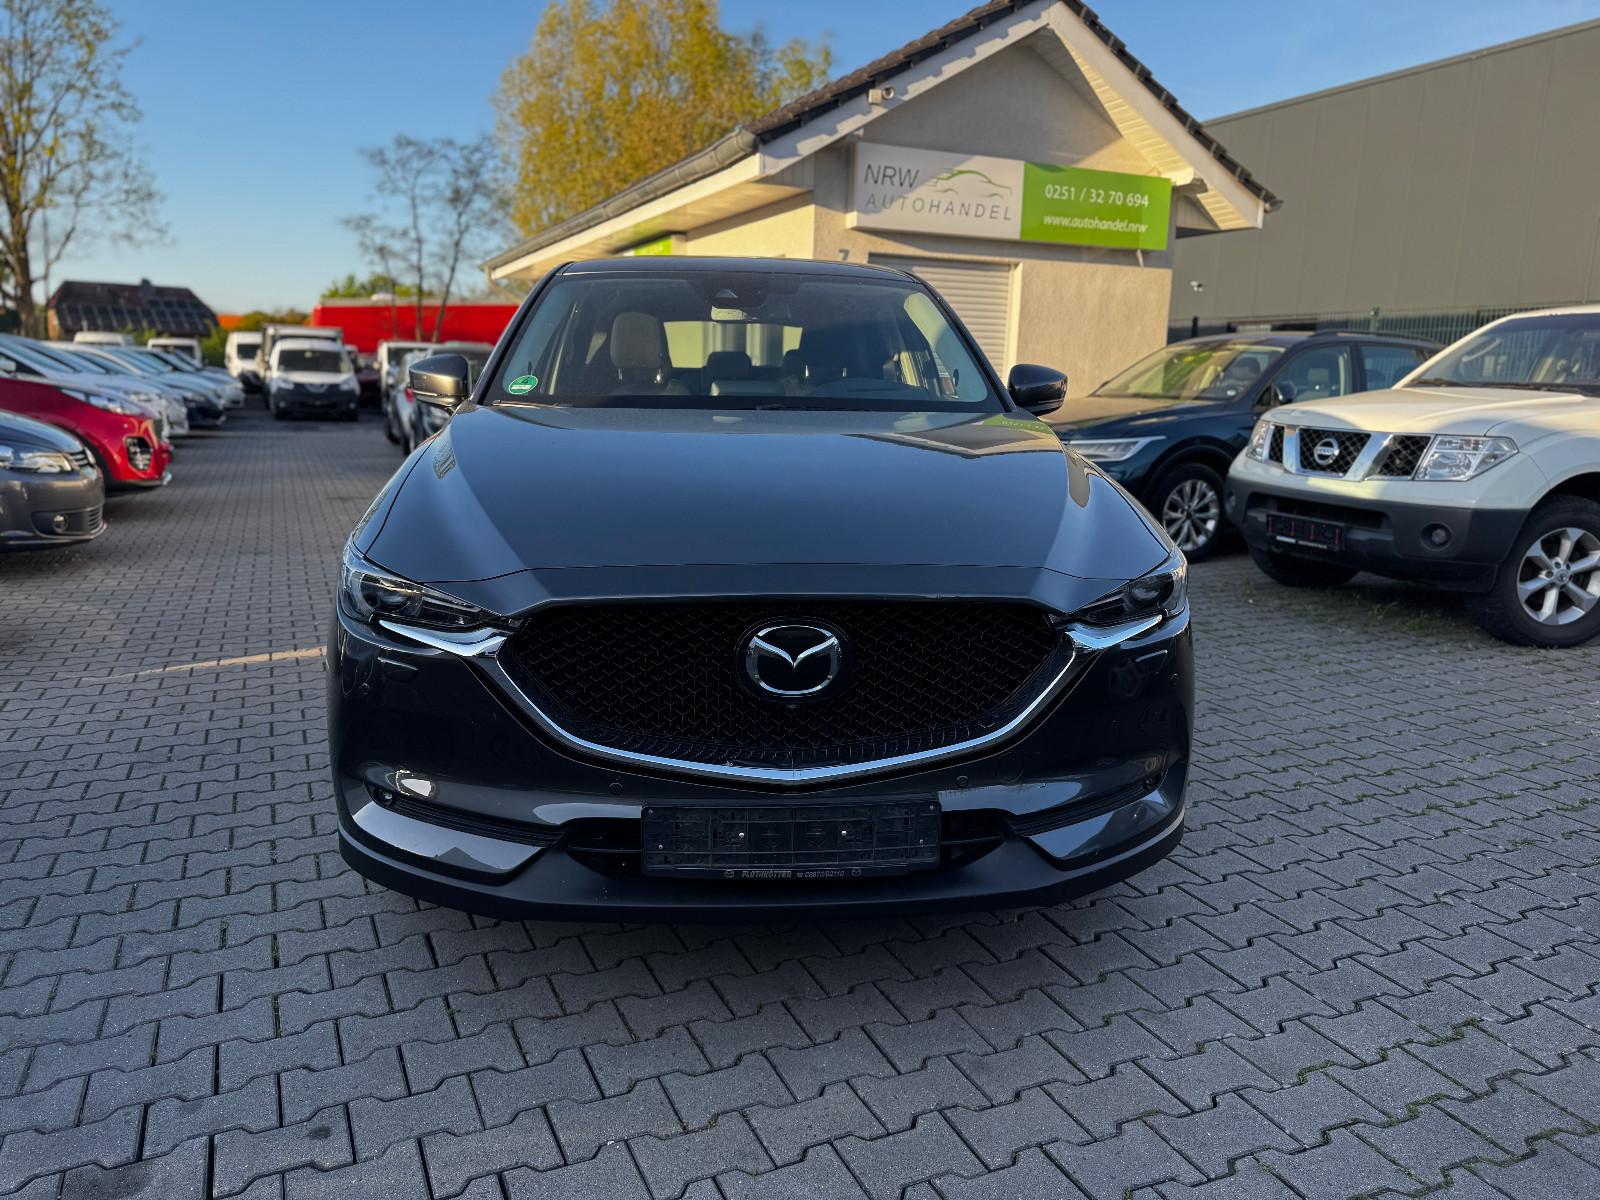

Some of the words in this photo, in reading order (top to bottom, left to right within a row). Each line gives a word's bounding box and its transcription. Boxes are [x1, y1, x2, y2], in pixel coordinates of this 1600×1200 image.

[864, 163, 920, 188] NRW
[865, 193, 1012, 221] AUTOHANDEL
[1045, 184, 1076, 201] 0251
[1080, 187, 1087, 202] /
[1089, 188, 1105, 204] 32
[1108, 190, 1124, 206] 70
[1126, 192, 1149, 208] 694
[1043, 215, 1149, 233] www.autohandel.nrw
